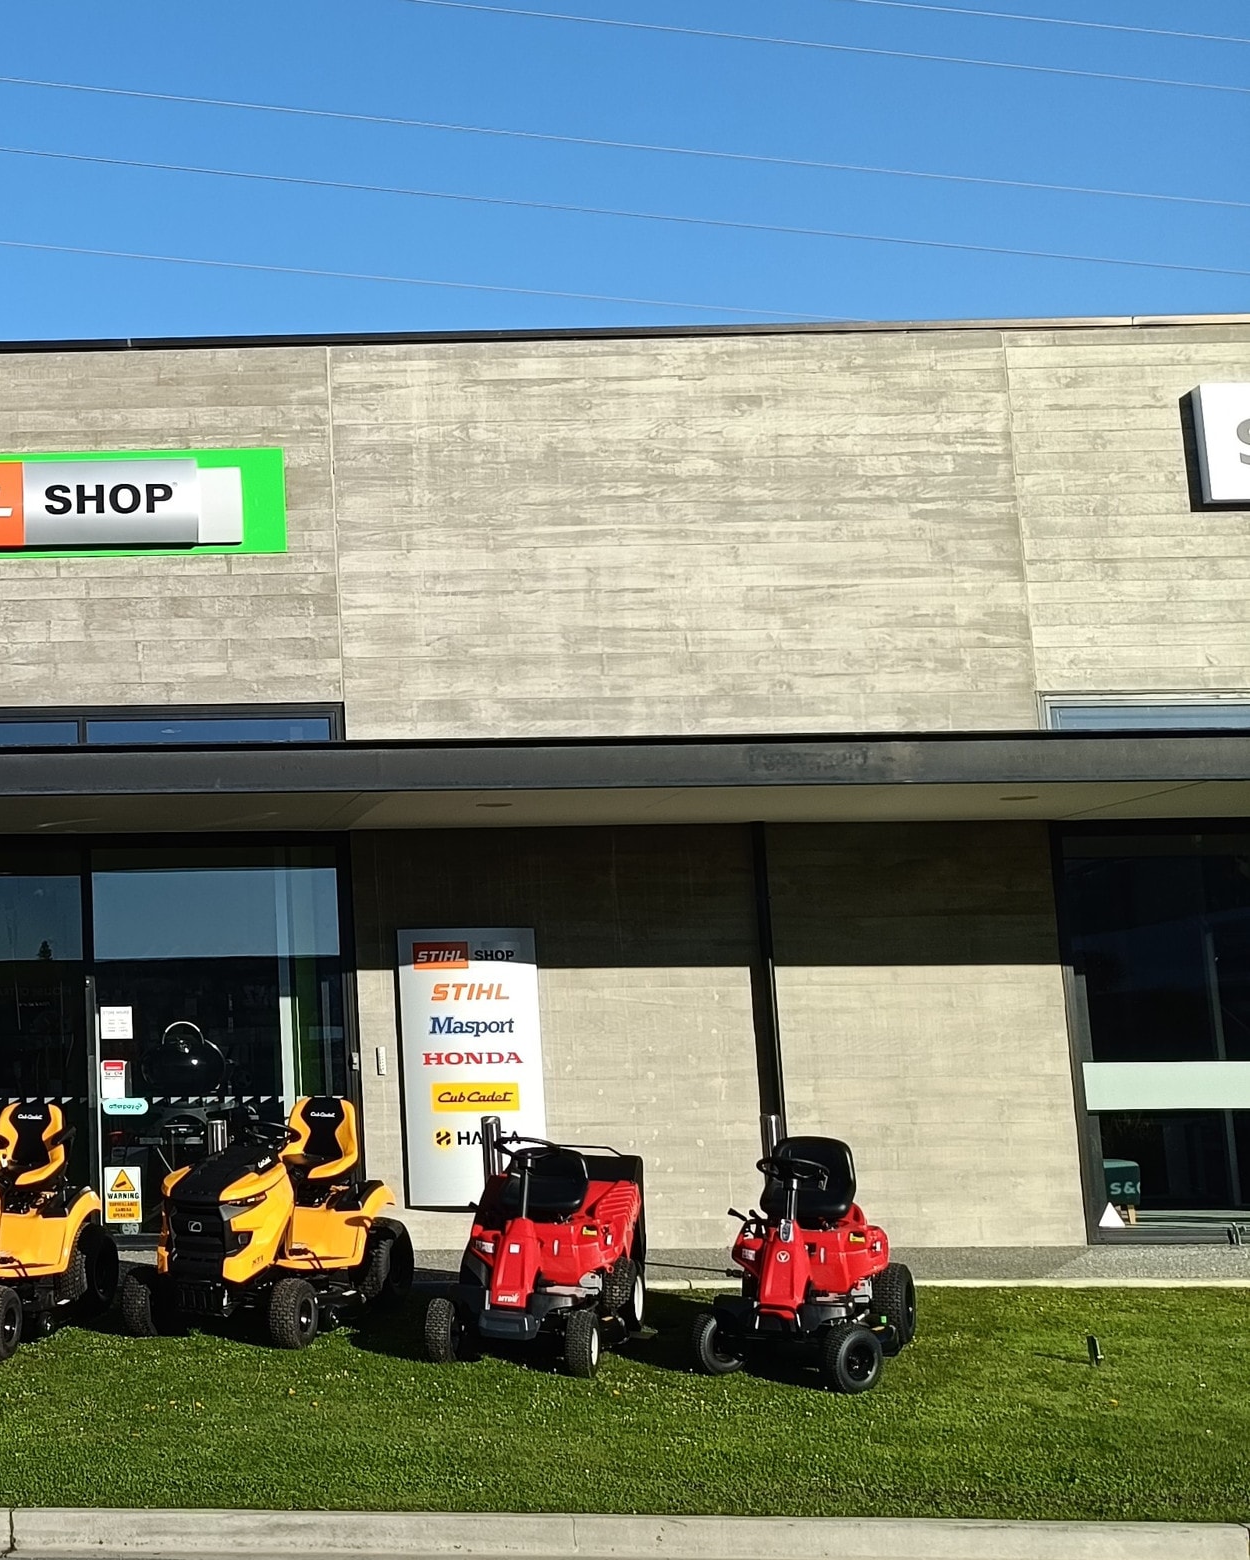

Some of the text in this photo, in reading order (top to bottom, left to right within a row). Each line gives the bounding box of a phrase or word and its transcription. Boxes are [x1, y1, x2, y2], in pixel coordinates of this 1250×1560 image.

[44, 483, 174, 515] SHOP
[417, 949, 515, 962] STIHL SHOP
[431, 983, 510, 1001] STIHL
[428, 1016, 515, 1037] Masport
[422, 1051, 524, 1066] HONDA
[437, 1091, 514, 1104] Cub Cadet
[457, 1130, 521, 1146] HAA
[107, 1192, 140, 1200] WARNING
